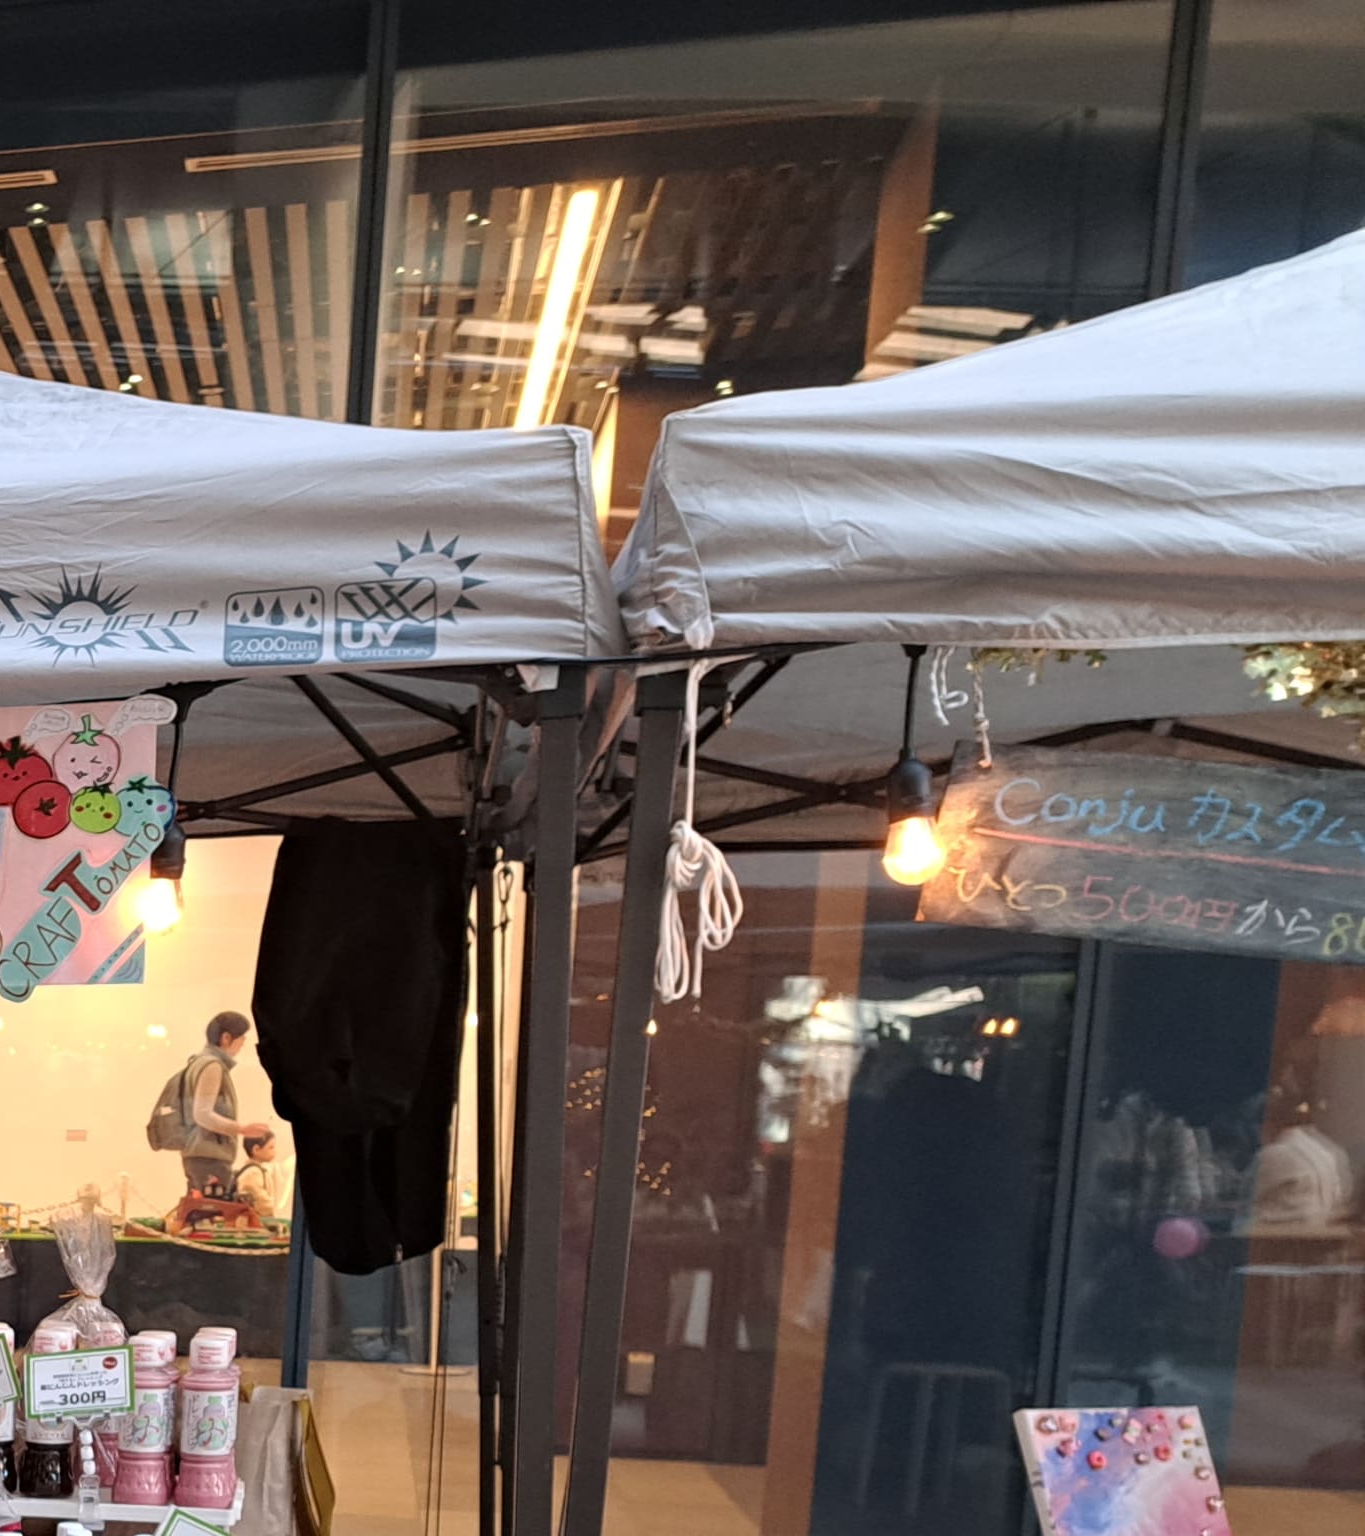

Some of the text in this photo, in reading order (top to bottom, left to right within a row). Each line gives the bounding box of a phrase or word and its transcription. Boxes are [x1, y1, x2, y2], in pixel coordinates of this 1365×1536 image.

[55, 609, 199, 634] SHIELD
[230, 636, 318, 655] 2,000mm
[341, 621, 405, 649] UV
[59, 1390, 106, 1406] 300円
